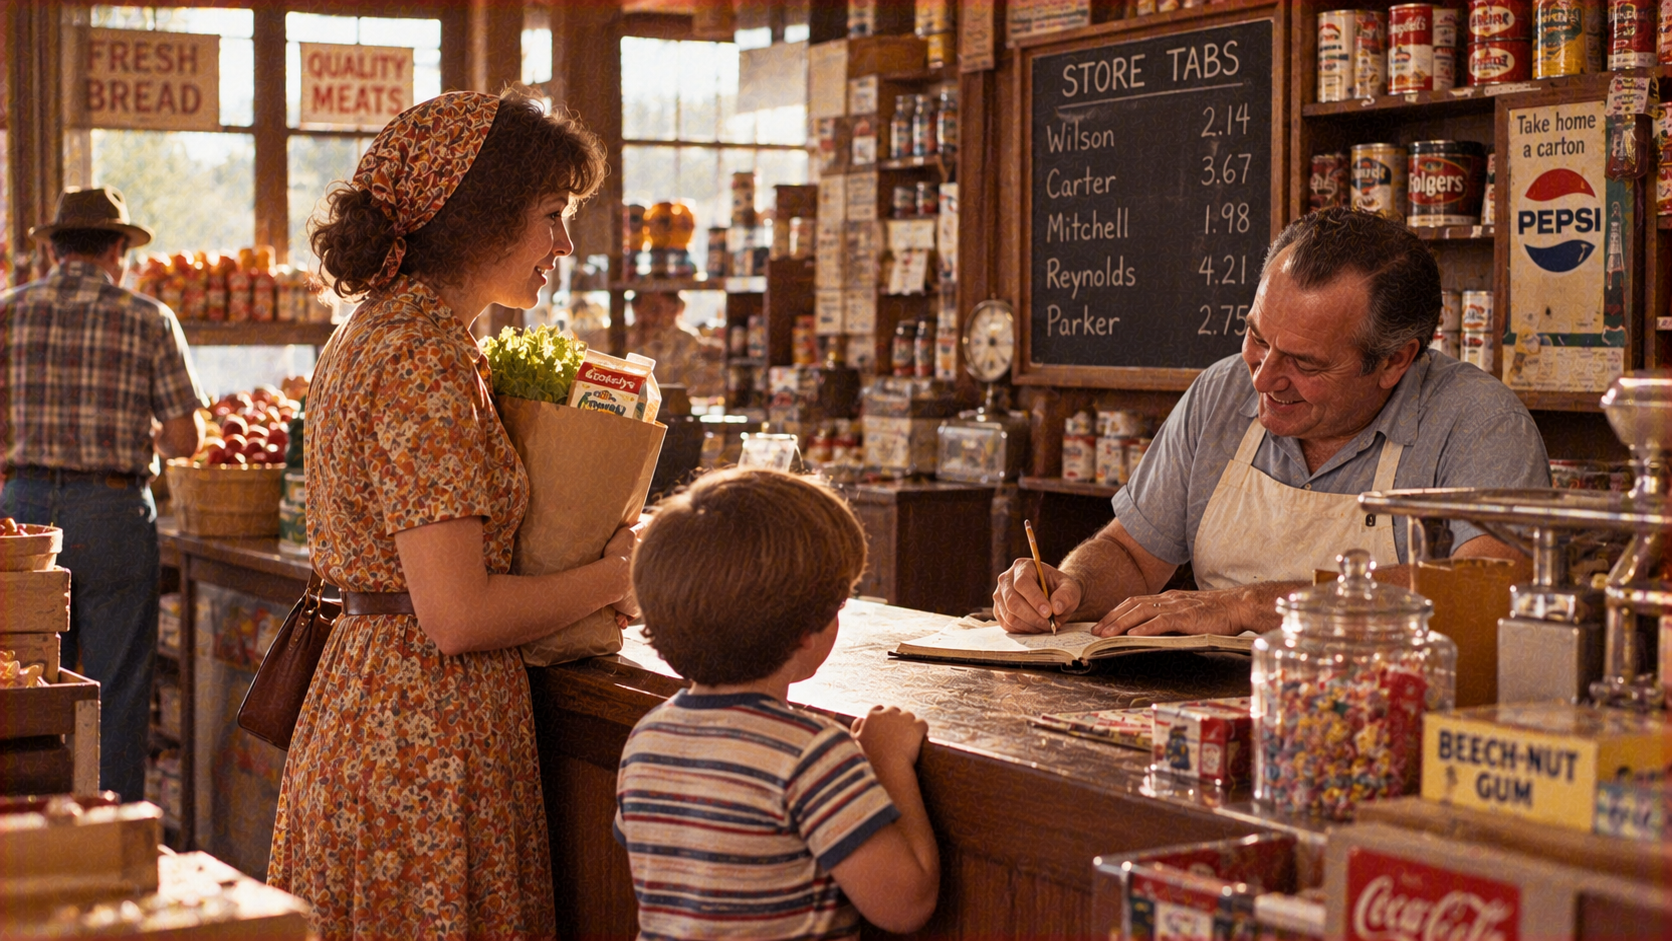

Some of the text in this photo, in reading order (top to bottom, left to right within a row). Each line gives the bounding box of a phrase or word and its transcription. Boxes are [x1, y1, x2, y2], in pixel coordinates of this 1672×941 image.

[89, 41, 197, 73] FRESH
[309, 50, 407, 80] QUALITY
[1063, 41, 1239, 97] STORE TABS
[87, 80, 201, 114] BREAD
[312, 86, 402, 114] MEATS
[1047, 103, 1251, 153] Wilson 2.14
[1517, 111, 1596, 135] Take home
[1523, 138, 1585, 158] a carton
[1047, 154, 1251, 198] Carter 3.67
[1409, 172, 1463, 197] Folgers
[1047, 202, 1250, 243] Mitchell 1.98
[1518, 208, 1600, 235] PEPSI
[1047, 254, 1246, 298] Reynolds 4.21
[1047, 304, 1248, 337] Parker 2.75
[1438, 731, 1578, 781] BEECH-NUT
[1476, 773, 1532, 807] GUM
